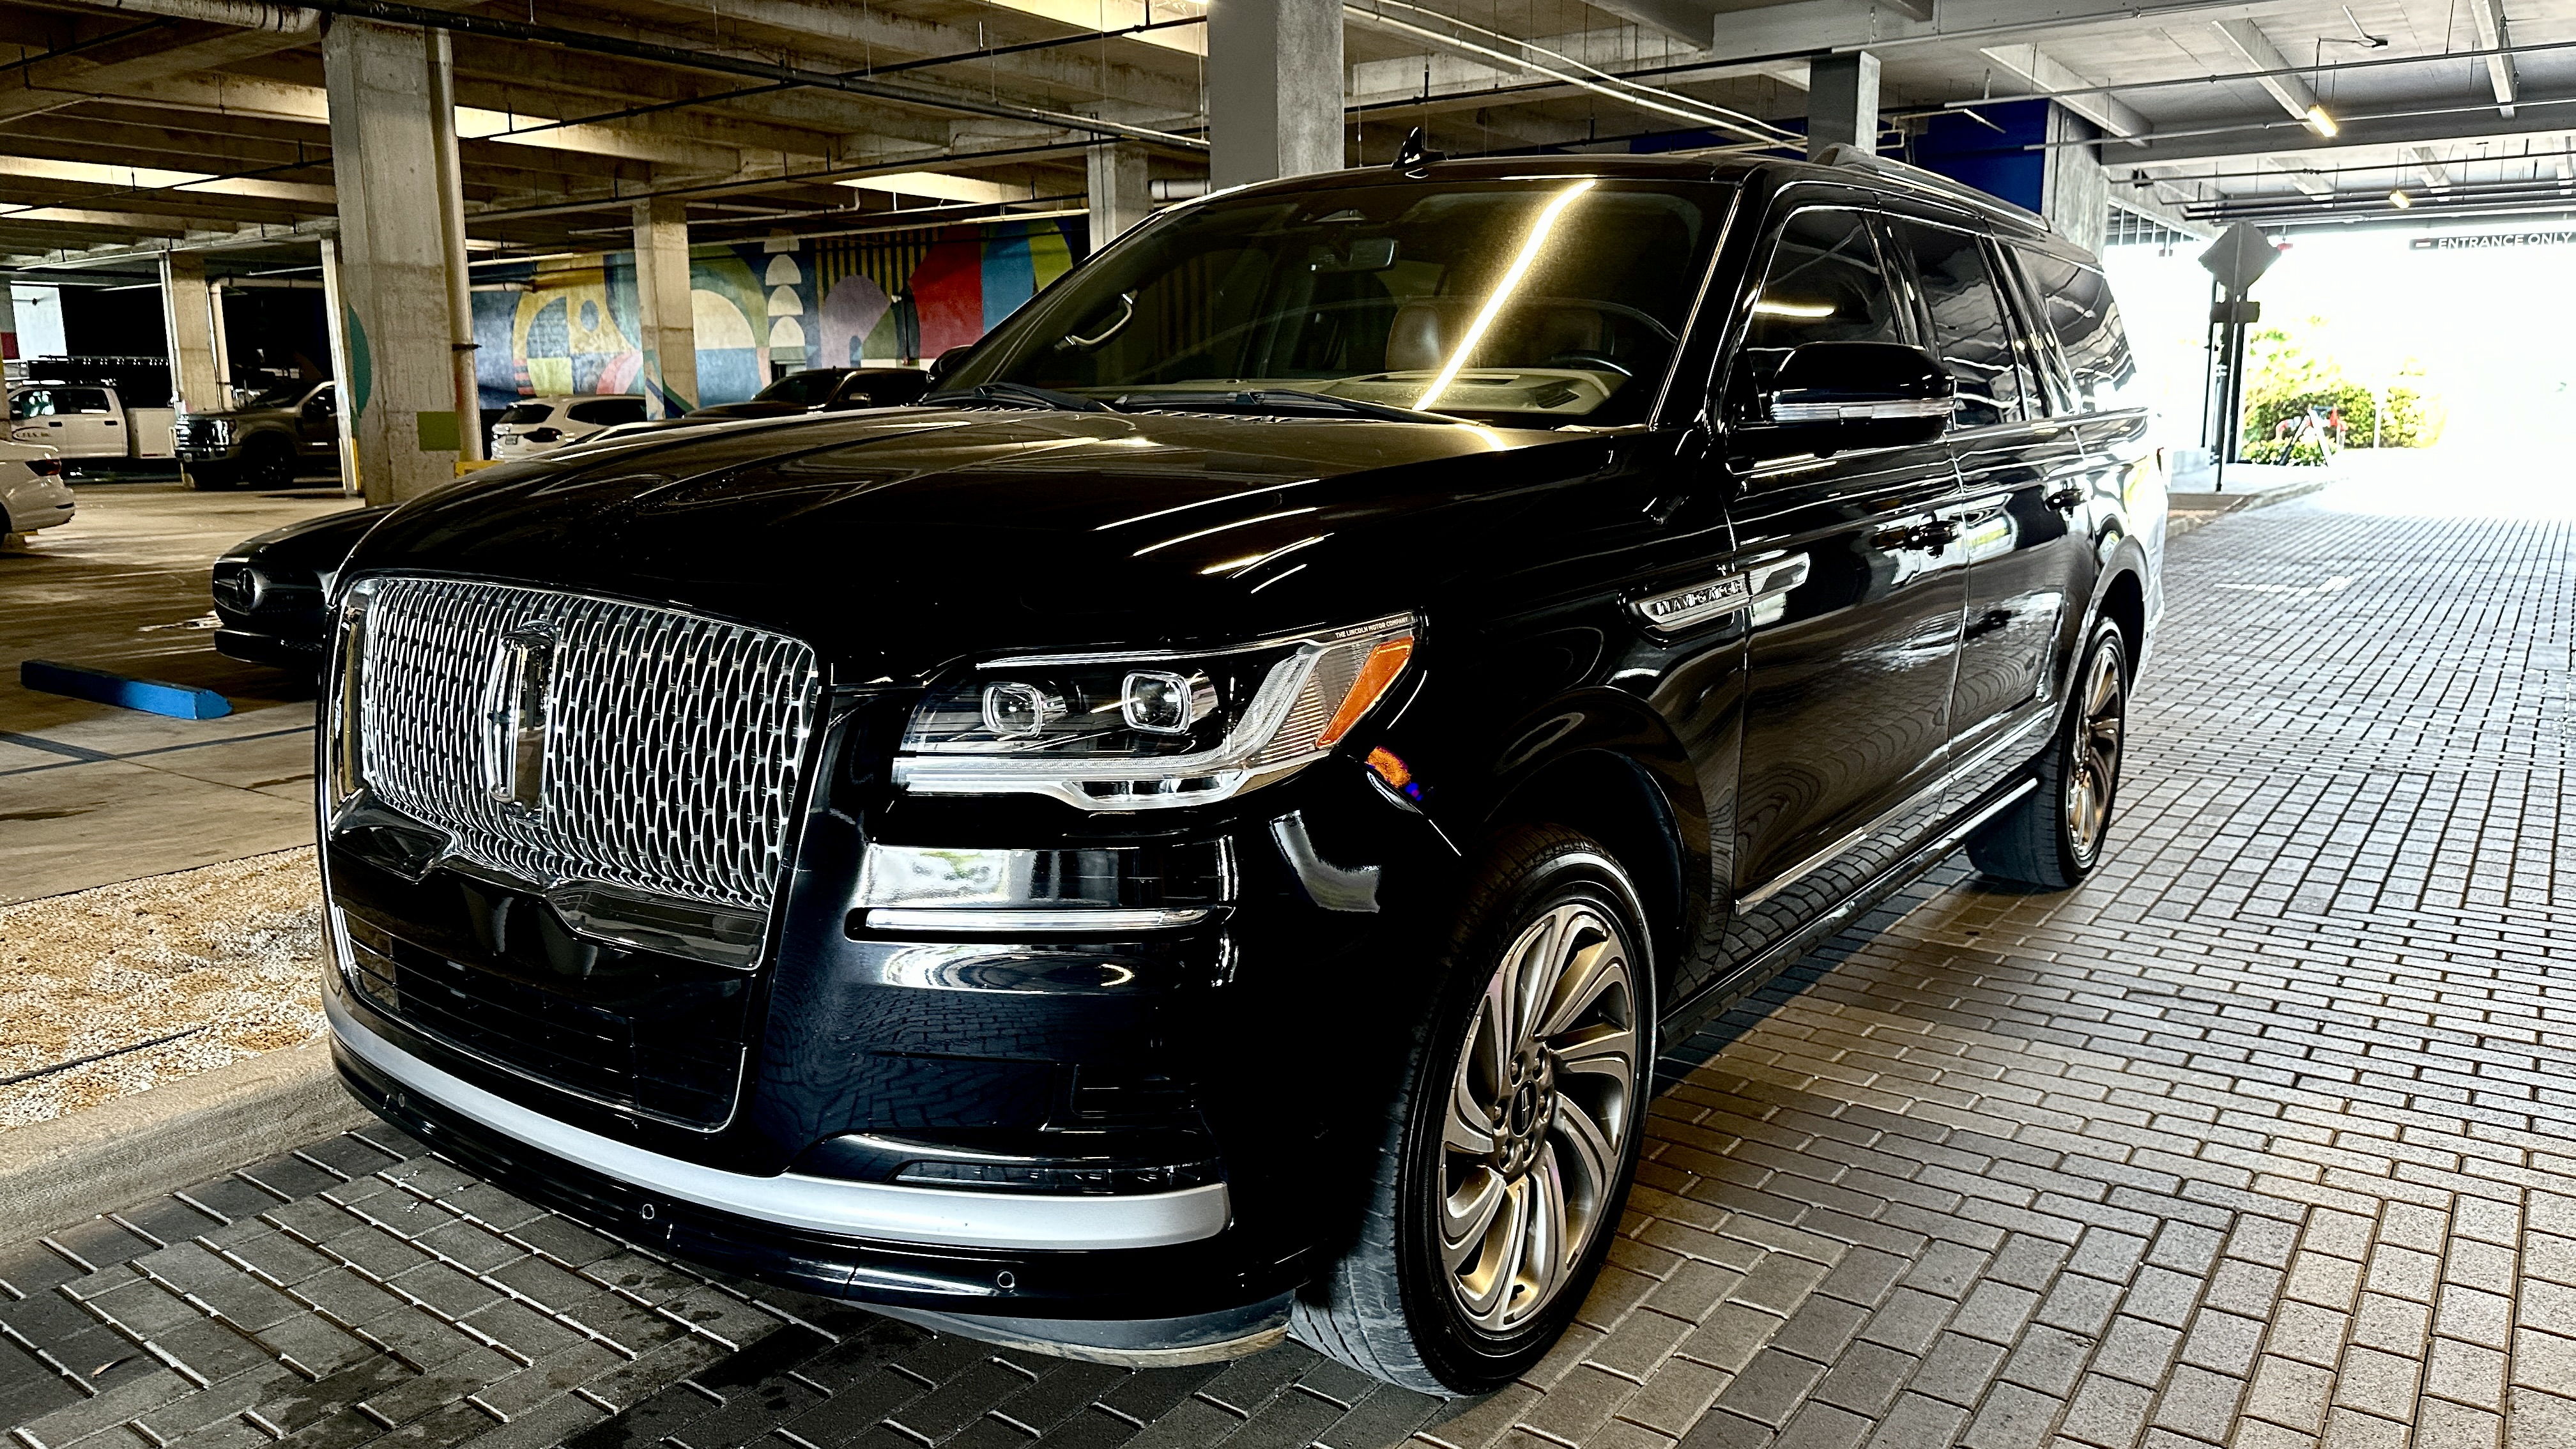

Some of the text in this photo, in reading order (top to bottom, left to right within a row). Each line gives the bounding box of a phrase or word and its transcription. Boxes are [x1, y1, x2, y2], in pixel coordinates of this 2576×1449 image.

[2437, 232, 2572, 250] ENTRANCE ONLY
[1655, 580, 1743, 616] NAVIGATOR
[1346, 627, 1368, 637] LINCOLN
[1368, 622, 1386, 631] MOTOR
[1386, 617, 1409, 627] COMPANY
